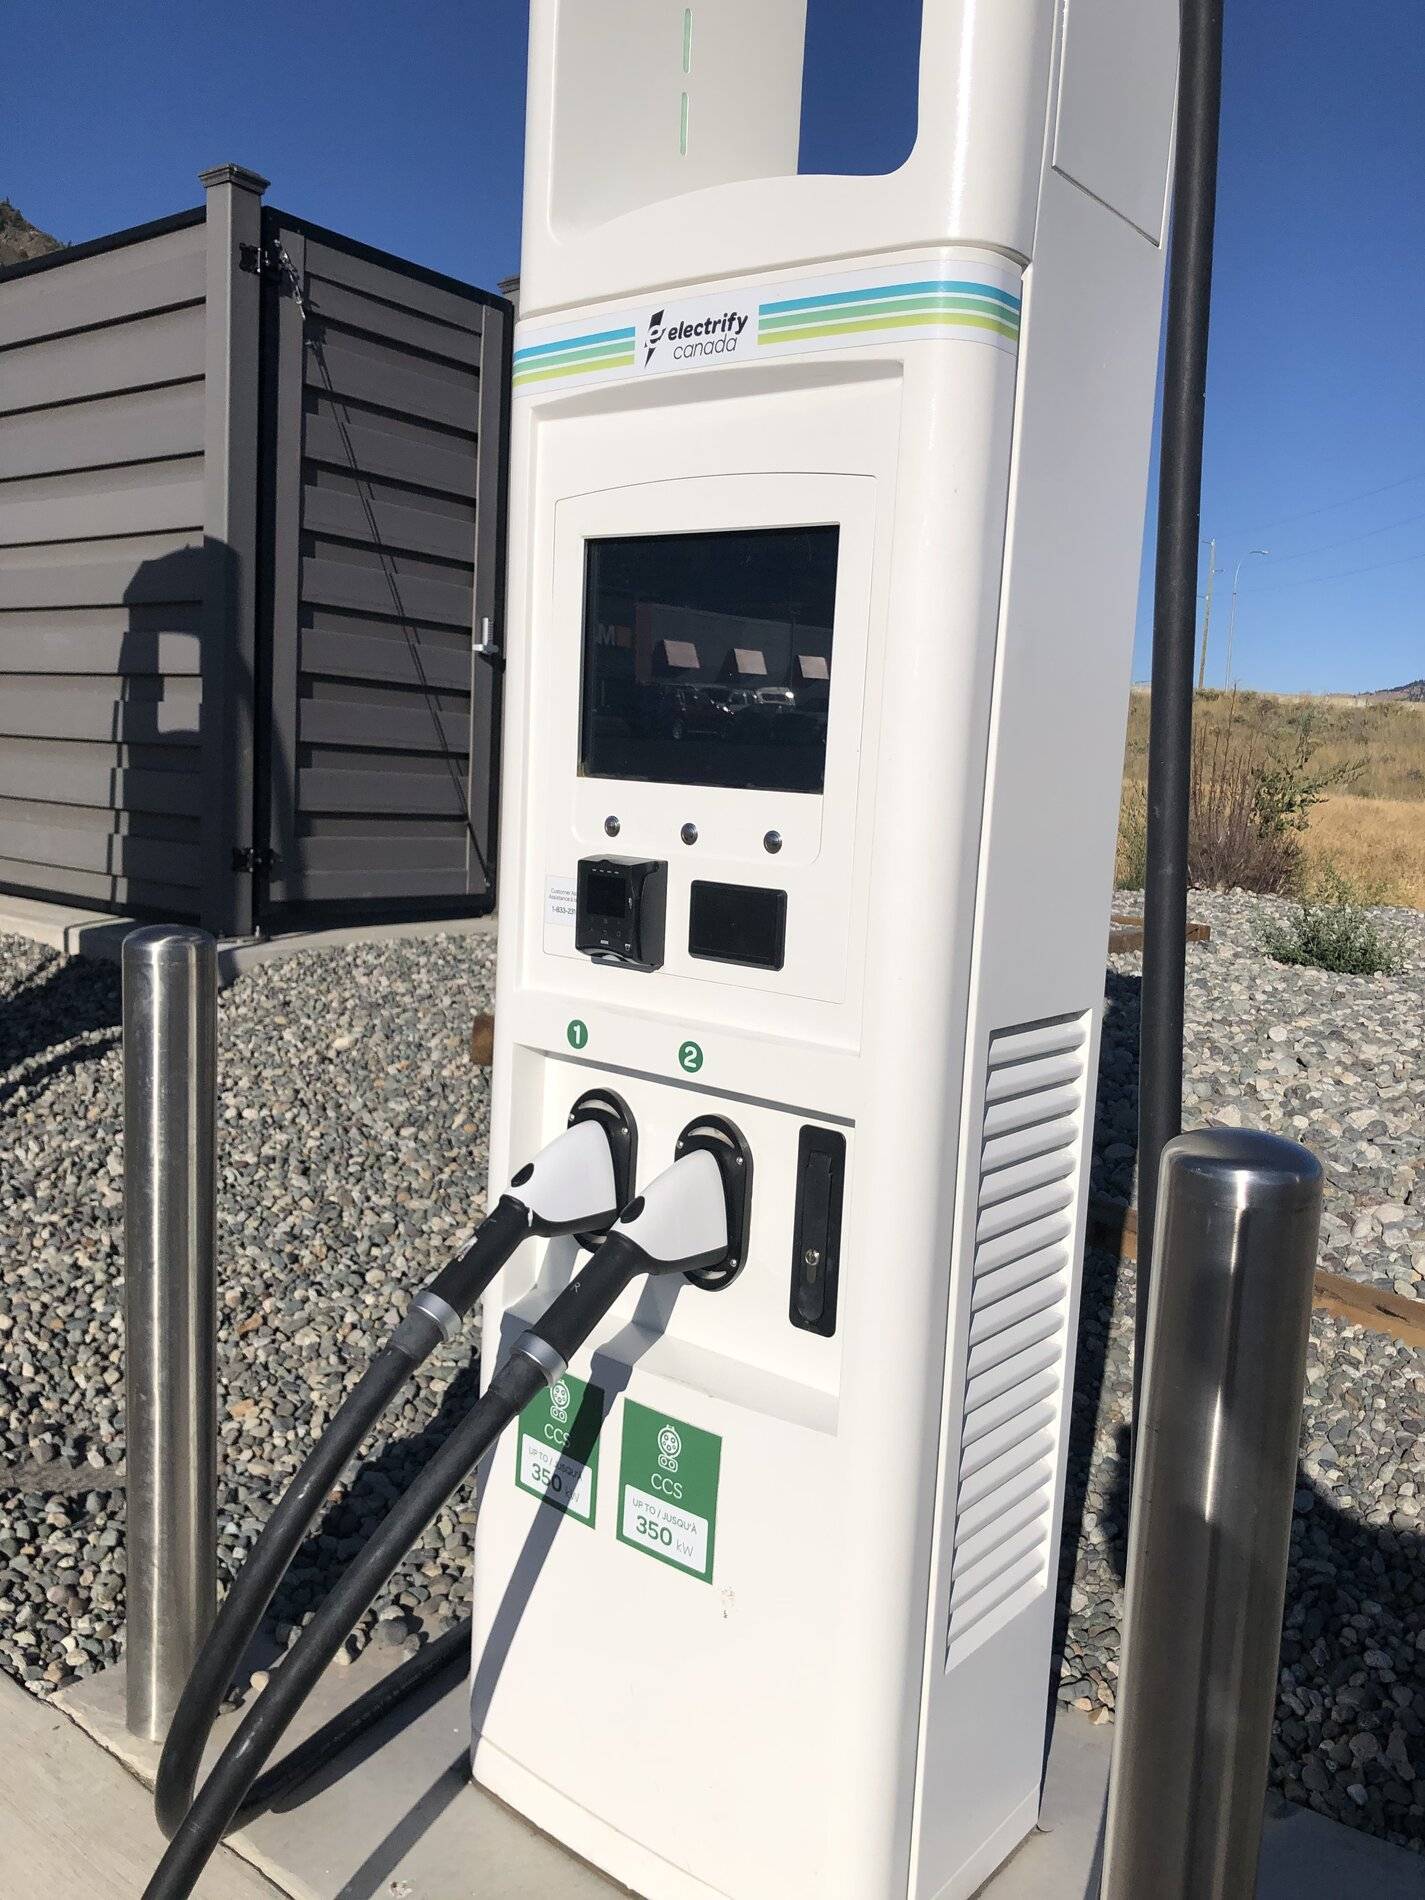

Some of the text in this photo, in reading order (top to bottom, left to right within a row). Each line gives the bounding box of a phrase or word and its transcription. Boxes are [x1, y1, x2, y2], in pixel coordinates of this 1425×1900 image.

[668, 312, 748, 341] electrify
[673, 333, 738, 360] canada
[573, 1024, 581, 1045] 1
[683, 1046, 698, 1068] 2
[544, 1423, 571, 1448] CCS
[531, 1462, 562, 1492] 350
[651, 1473, 683, 1499] CCS
[632, 1497, 643, 1509] UP
[644, 1503, 656, 1515] TO
[636, 1515, 694, 1557] 350 kW
